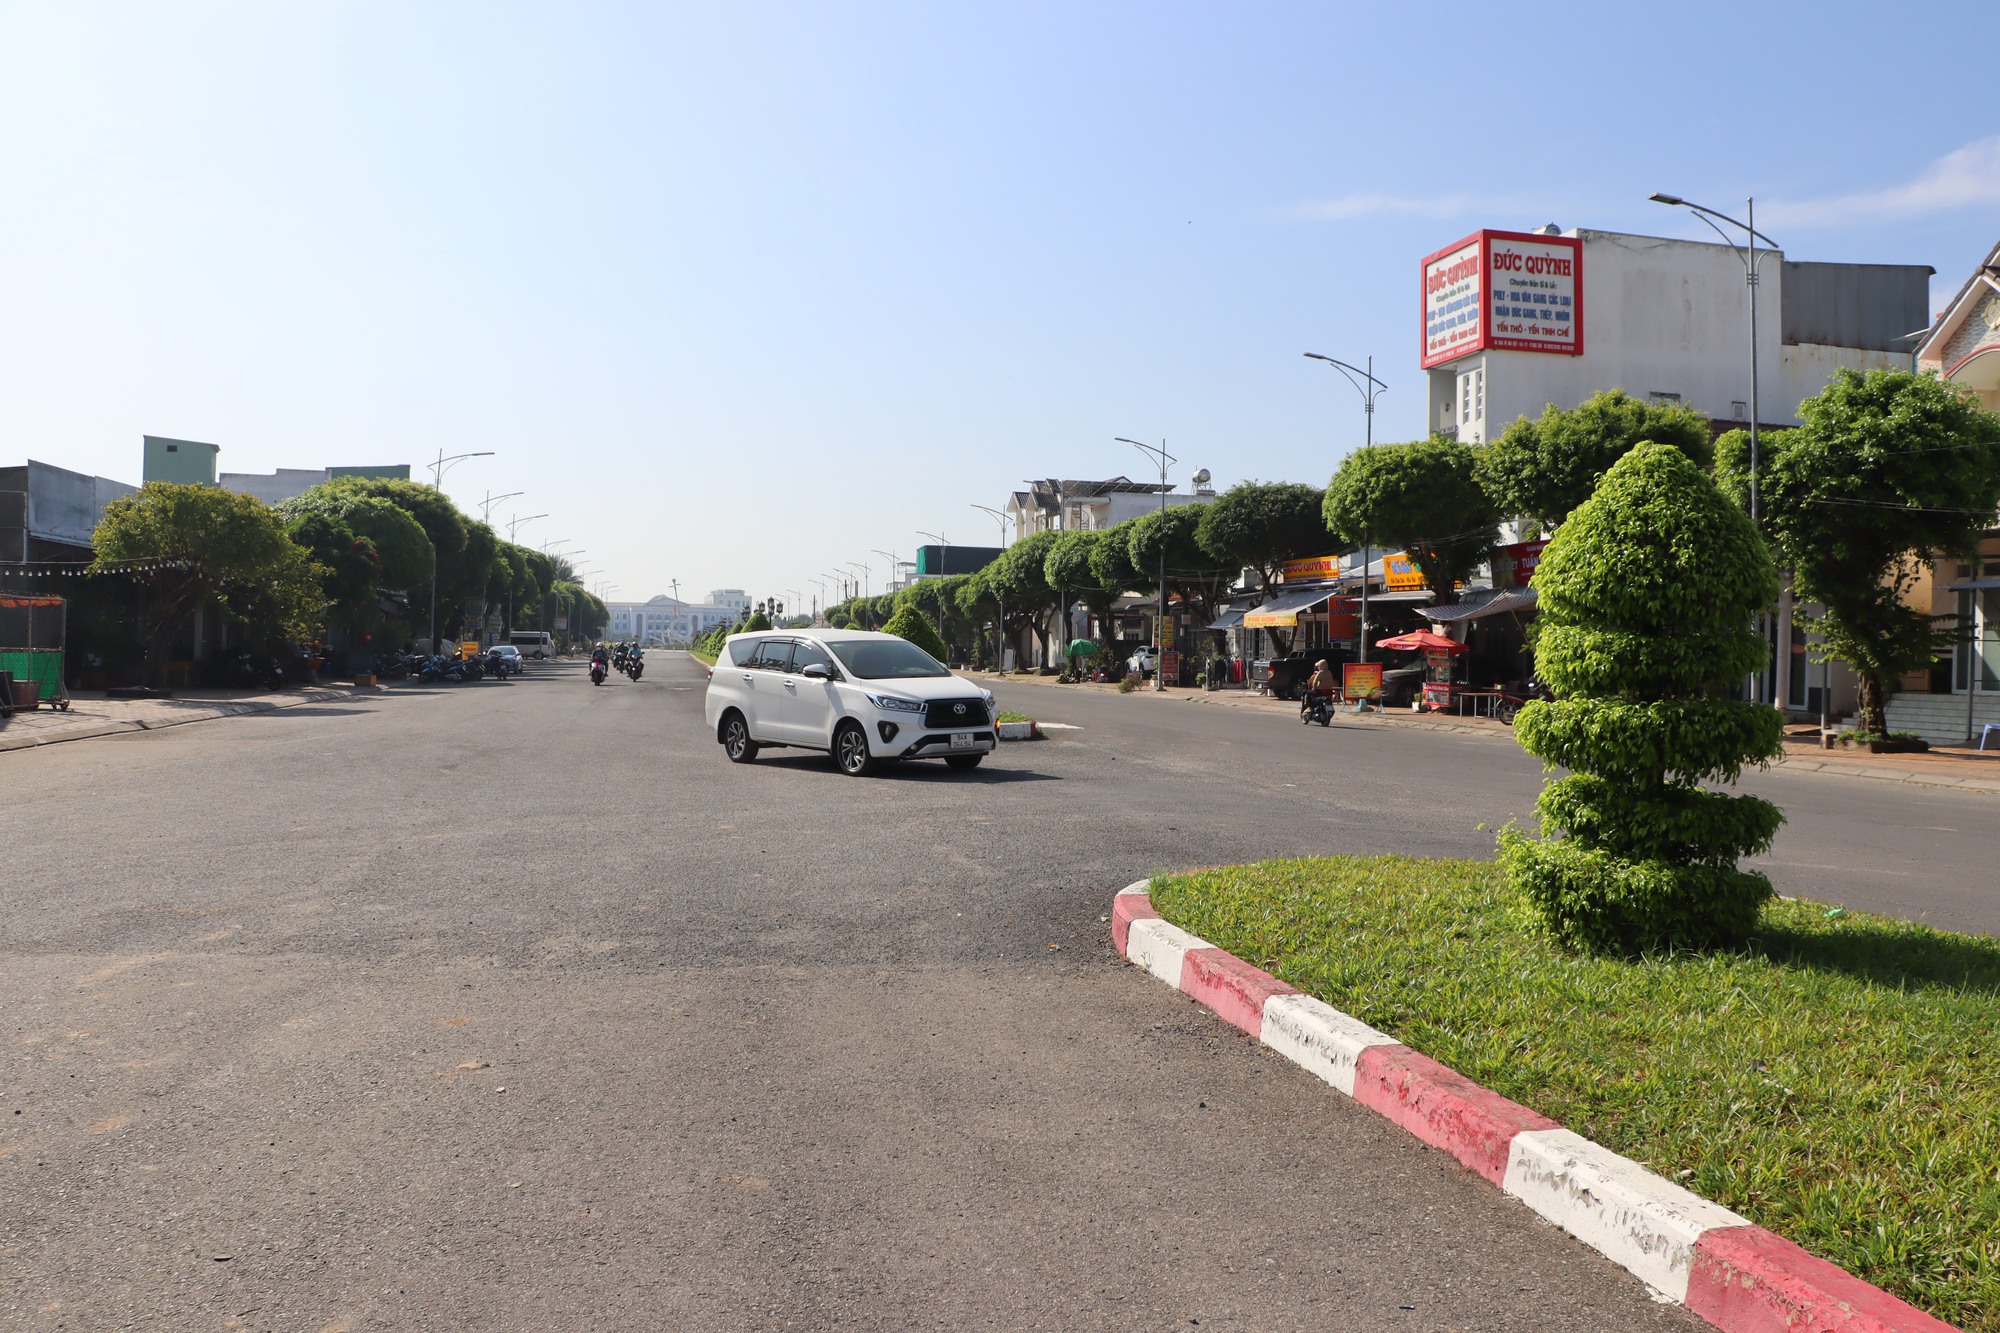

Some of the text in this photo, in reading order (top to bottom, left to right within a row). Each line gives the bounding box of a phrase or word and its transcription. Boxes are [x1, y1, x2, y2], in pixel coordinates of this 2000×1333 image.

[1428, 255, 1478, 294] ĐỨC QUỲNH
[1494, 248, 1571, 276] ĐỨC QUỲNH
[1497, 321, 1508, 332] YẾN
[1528, 323, 1539, 334] YẾN
[1557, 326, 1570, 337] CHẾ
